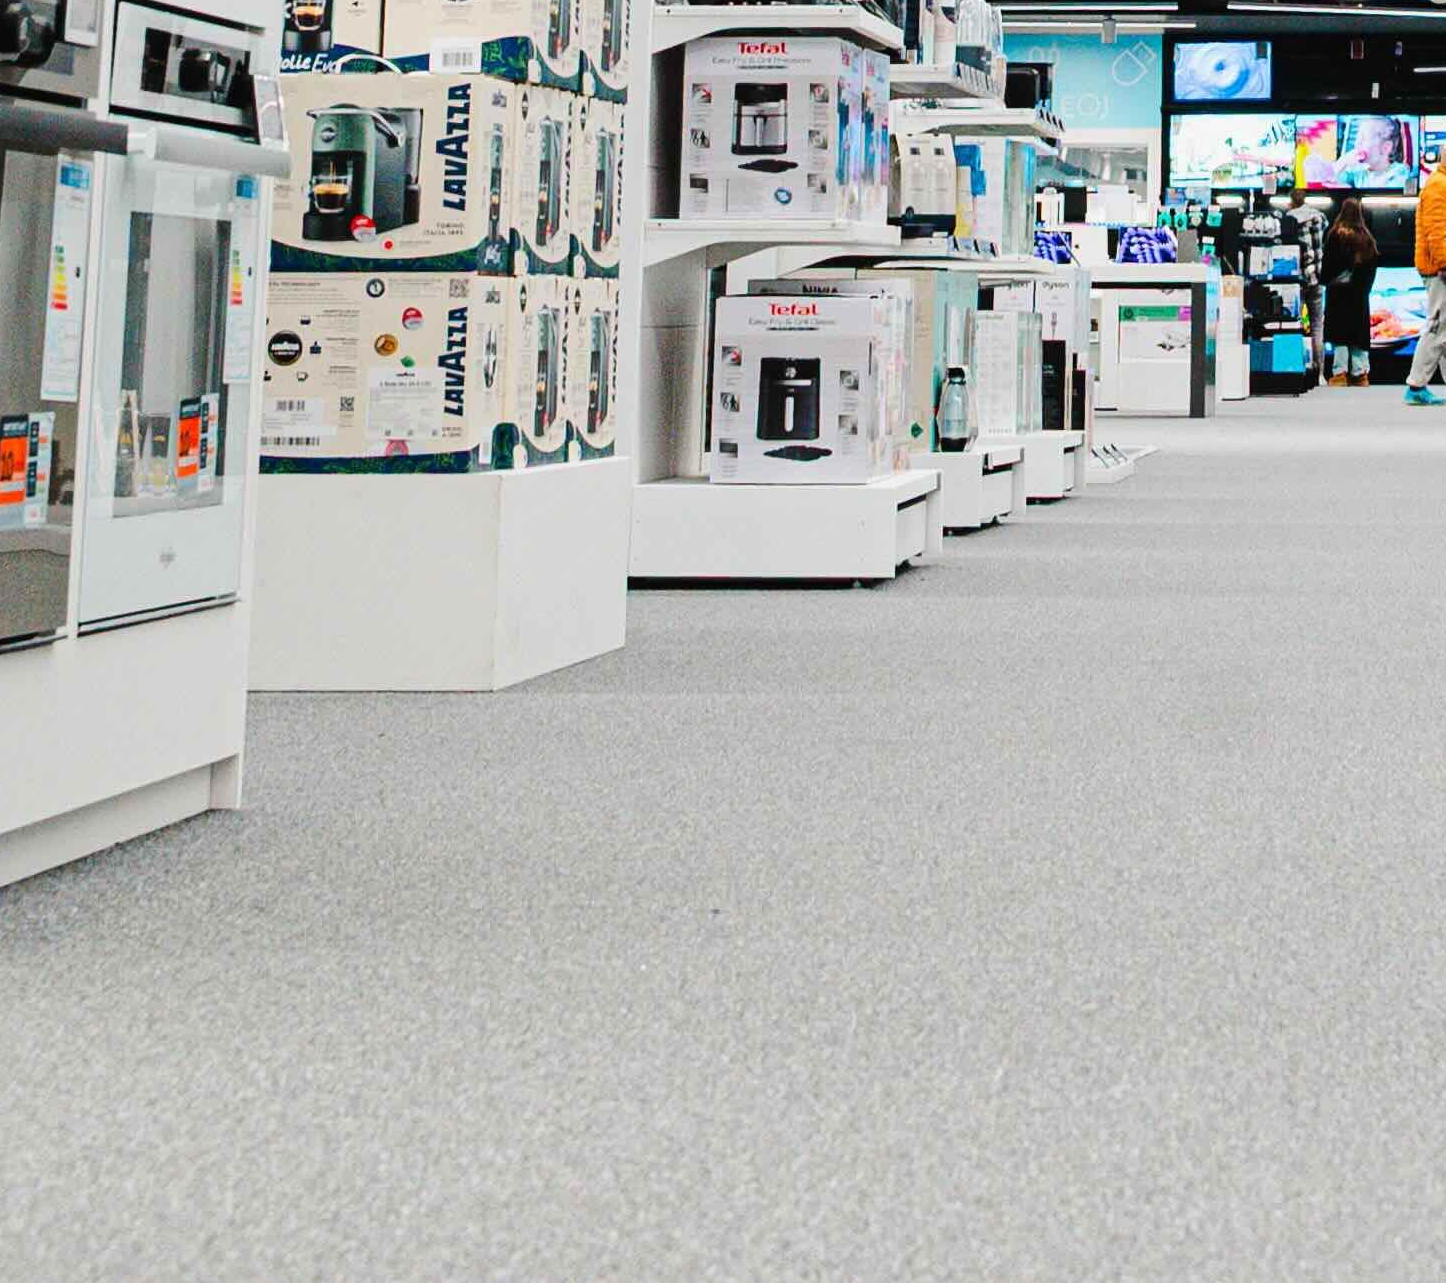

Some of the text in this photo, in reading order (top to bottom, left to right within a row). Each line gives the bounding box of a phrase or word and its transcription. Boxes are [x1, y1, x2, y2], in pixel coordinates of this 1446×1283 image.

[737, 42, 787, 54] Tefal
[281, 54, 311, 70] olie
[436, 82, 472, 212] LAVAZZA
[769, 302, 818, 315] Tefal
[438, 306, 469, 417] LAVAZZA
